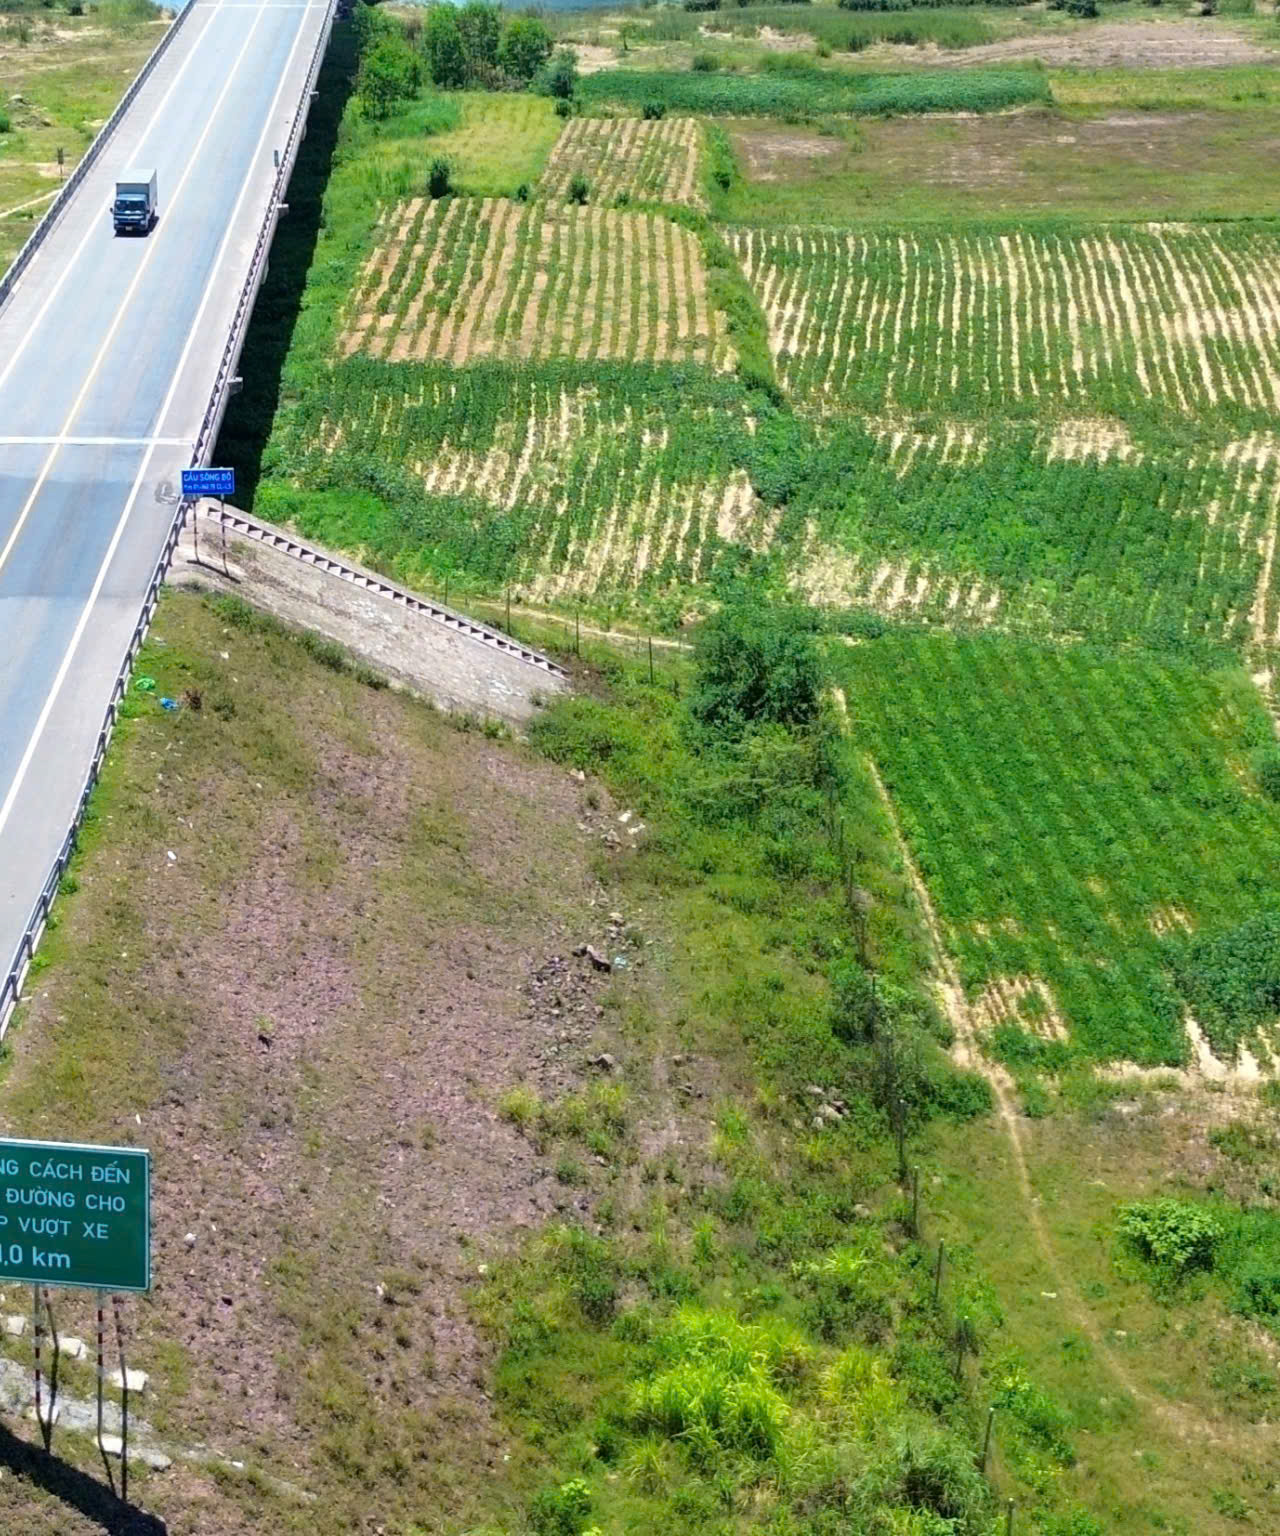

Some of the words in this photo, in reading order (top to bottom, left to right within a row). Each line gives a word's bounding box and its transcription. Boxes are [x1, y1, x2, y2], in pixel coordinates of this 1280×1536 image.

[200, 472, 220, 481] SÔNG
[29, 1158, 83, 1180] CÁCH
[91, 1161, 130, 1184] ĐẾN
[5, 1185, 76, 1208] ĐƯỜNG
[85, 1194, 126, 1212] CHO
[18, 1216, 72, 1238] VƯỢT
[82, 1221, 109, 1239] XE
[32, 1246, 71, 1268] km
